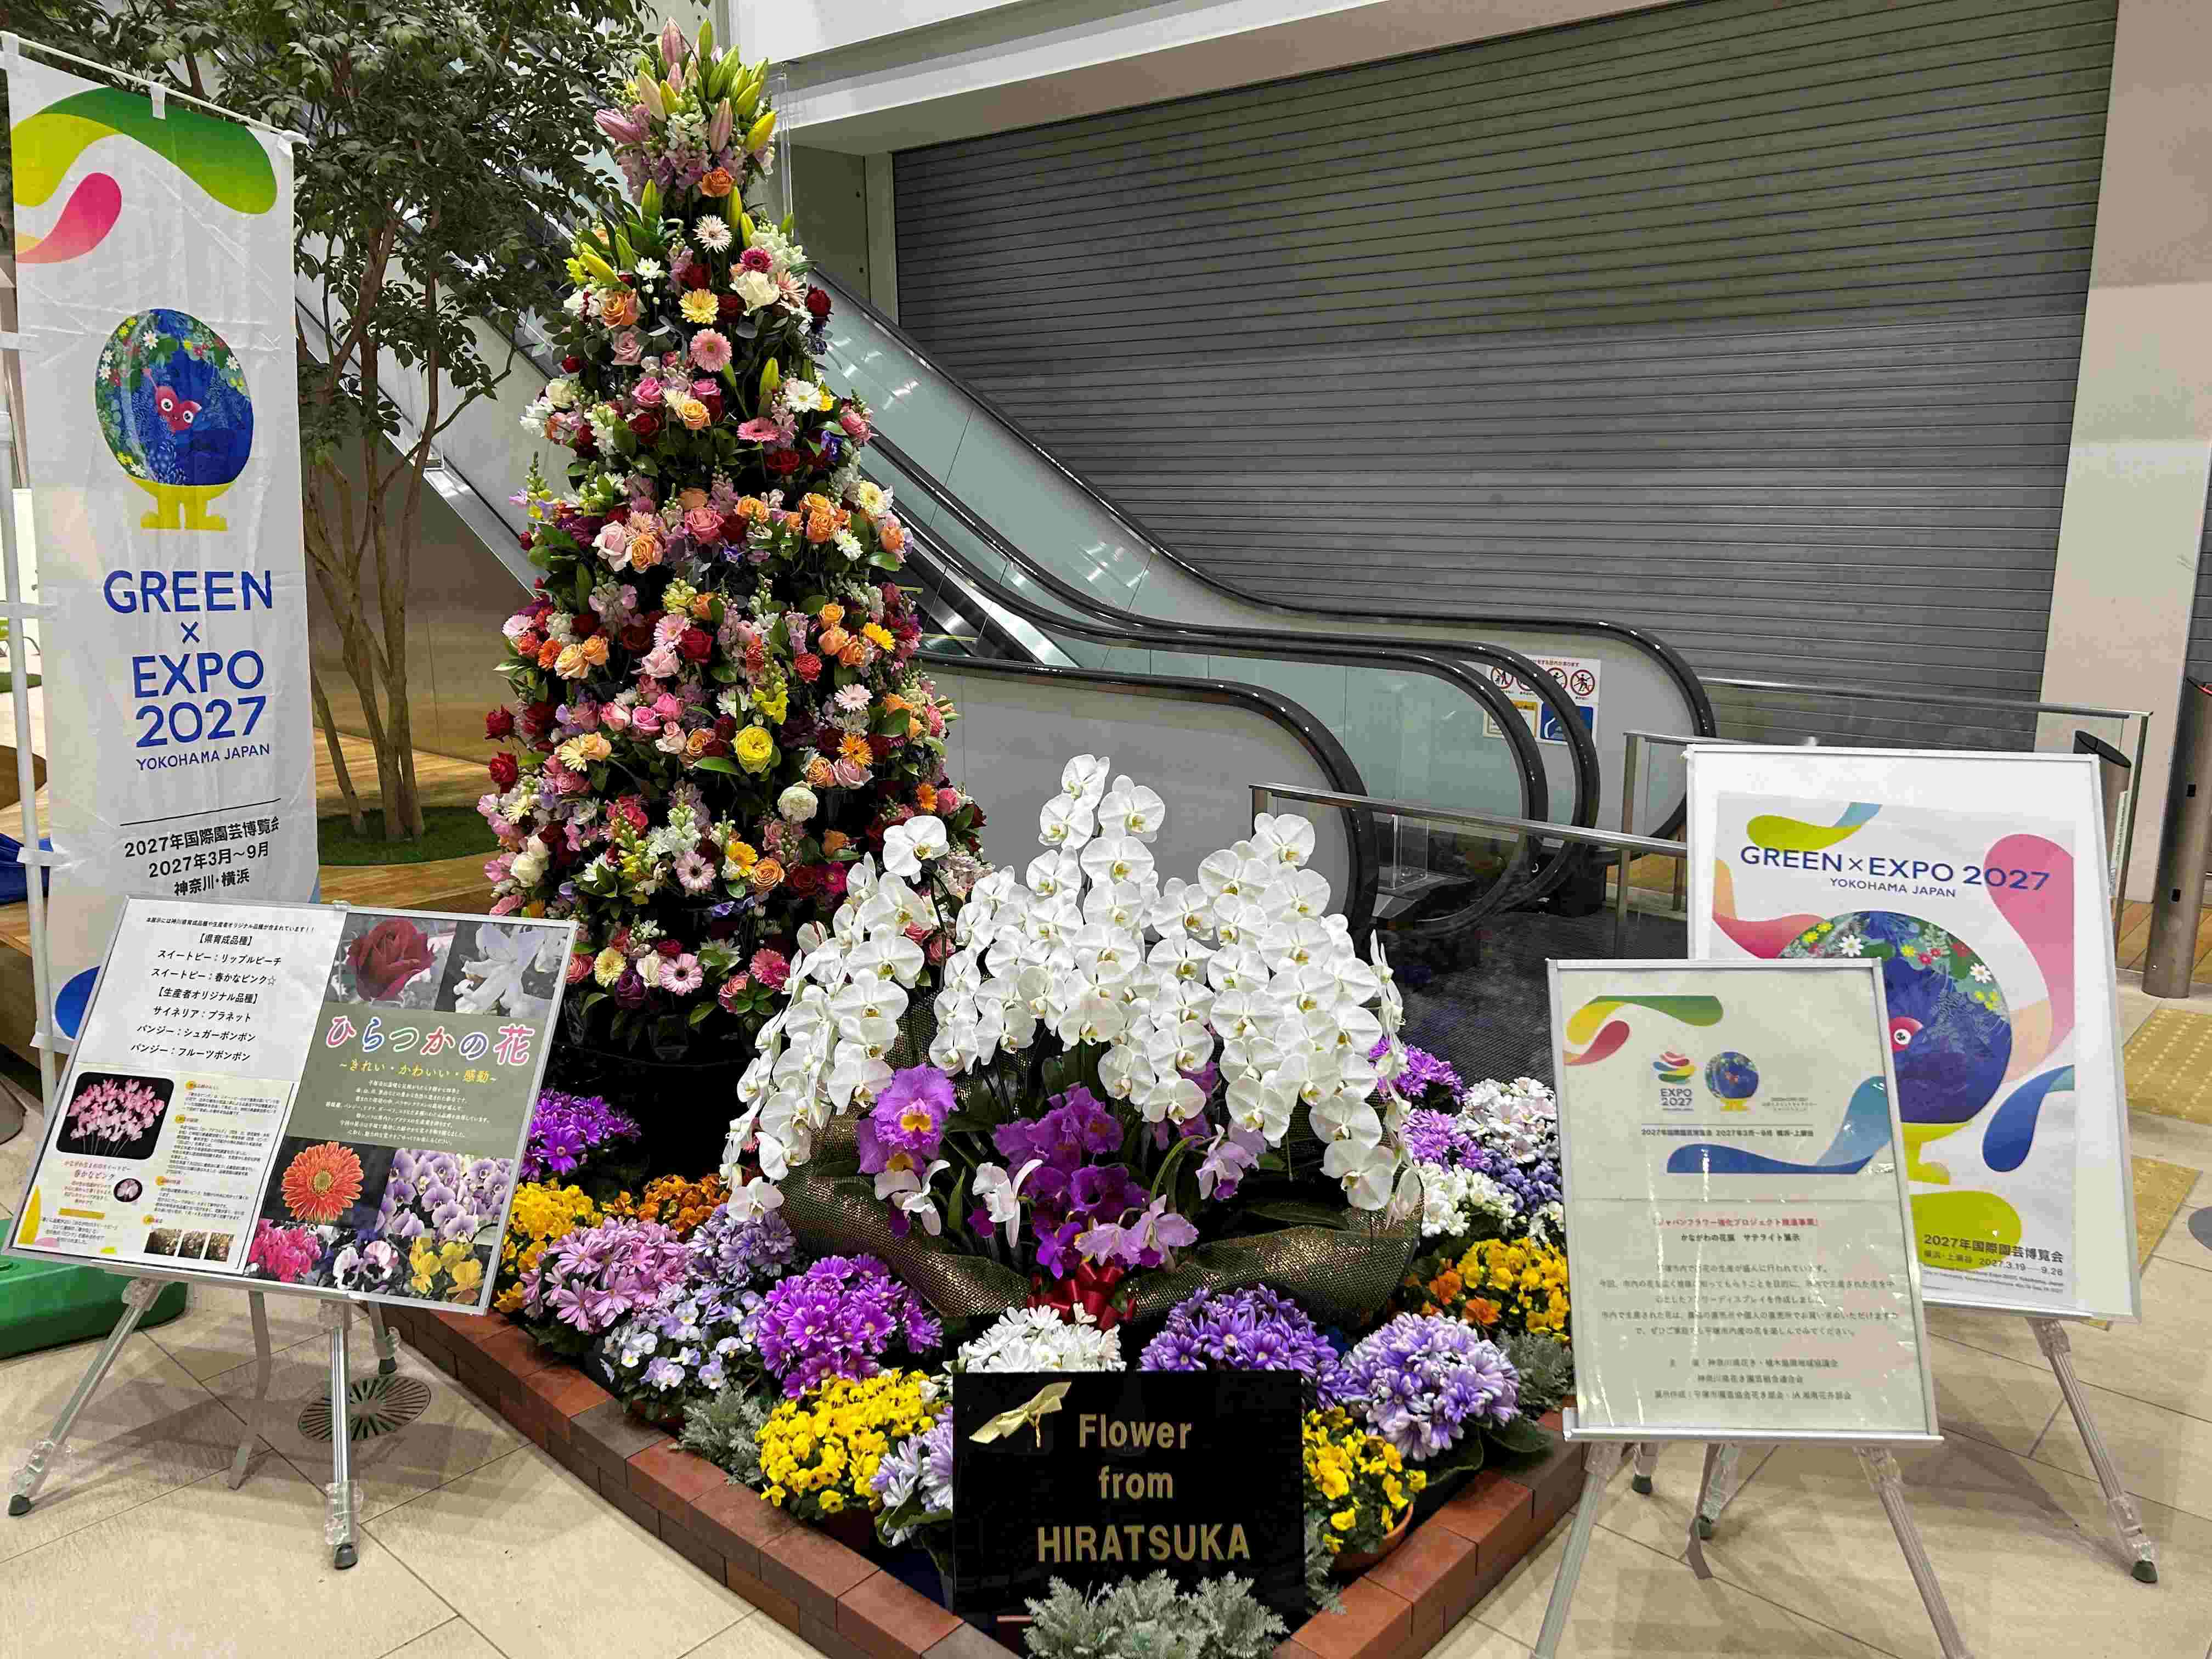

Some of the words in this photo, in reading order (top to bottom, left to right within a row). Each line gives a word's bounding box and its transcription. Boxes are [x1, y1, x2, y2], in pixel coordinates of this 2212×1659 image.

[104, 569, 273, 613] GREEN
[132, 650, 264, 698] EXPO
[136, 696, 267, 747] 2027
[136, 750, 220, 771] YOKOHAMA
[224, 743, 270, 760] JAPAN
[124, 816, 280, 858] 2027年国際園芸博覧会
[1830, 878, 1908, 893] YOKOHAMA
[1912, 886, 1956, 898] JAPAN
[1962, 865, 2050, 891] 2027
[326, 1015, 536, 1066] ひらつかの花
[1660, 1088, 1692, 1097] EXPO
[1661, 1097, 1692, 1107] 2027
[1923, 1234, 2063, 1264] 2027年国際園芸博覧会
[1079, 1413, 1192, 1449] Flower
[1098, 1465, 1173, 1499] from
[1037, 1523, 1250, 1562] HIRATSUKA
